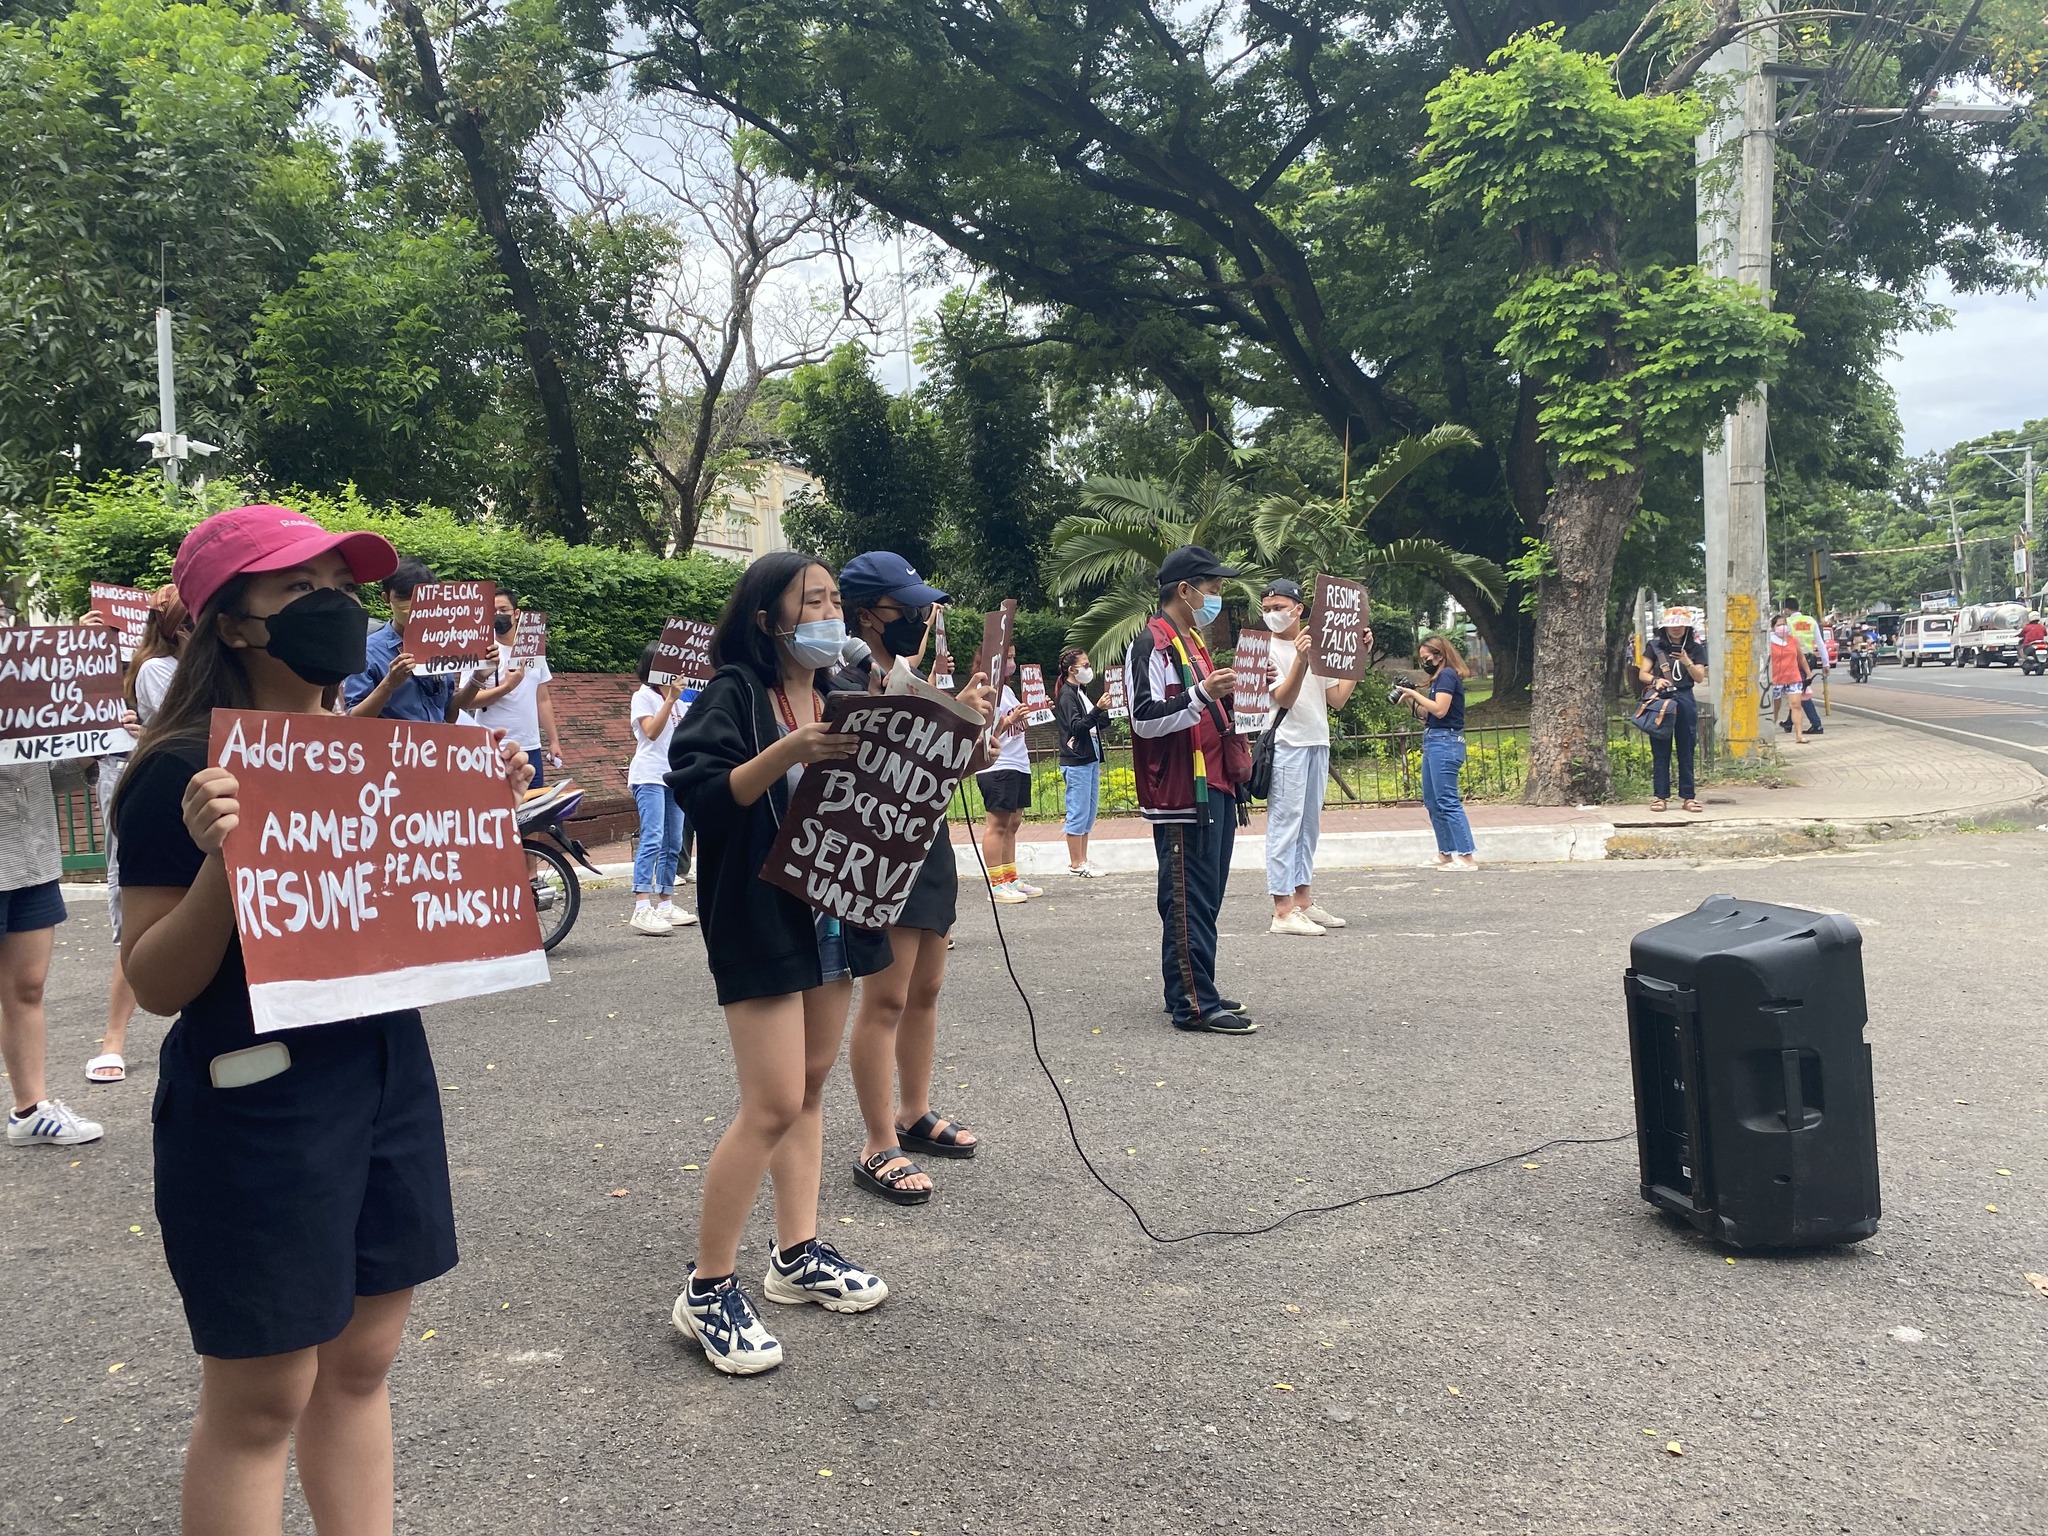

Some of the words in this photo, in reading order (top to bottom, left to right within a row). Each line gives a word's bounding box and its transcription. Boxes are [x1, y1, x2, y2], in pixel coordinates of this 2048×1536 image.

[416, 584, 484, 602] NTF-ELCAC,
[1326, 584, 1361, 611] RESUME
[408, 604, 471, 624] panubagon
[474, 606, 485, 624] ug
[421, 625, 490, 648] bungkagon!!!
[1321, 628, 1358, 653] TALKS
[0, 654, 118, 682] ANUBAGON
[51, 681, 83, 703] UG
[218, 718, 366, 774] Address
[388, 726, 437, 768] the
[446, 731, 507, 779] roots
[359, 771, 400, 817] of
[815, 769, 927, 843] Basic
[260, 809, 378, 858] ARMED
[390, 808, 521, 849] CONFLICT!
[384, 851, 462, 886] PEACE
[236, 861, 378, 939] RESUME
[412, 885, 521, 931] TALKS!!!
